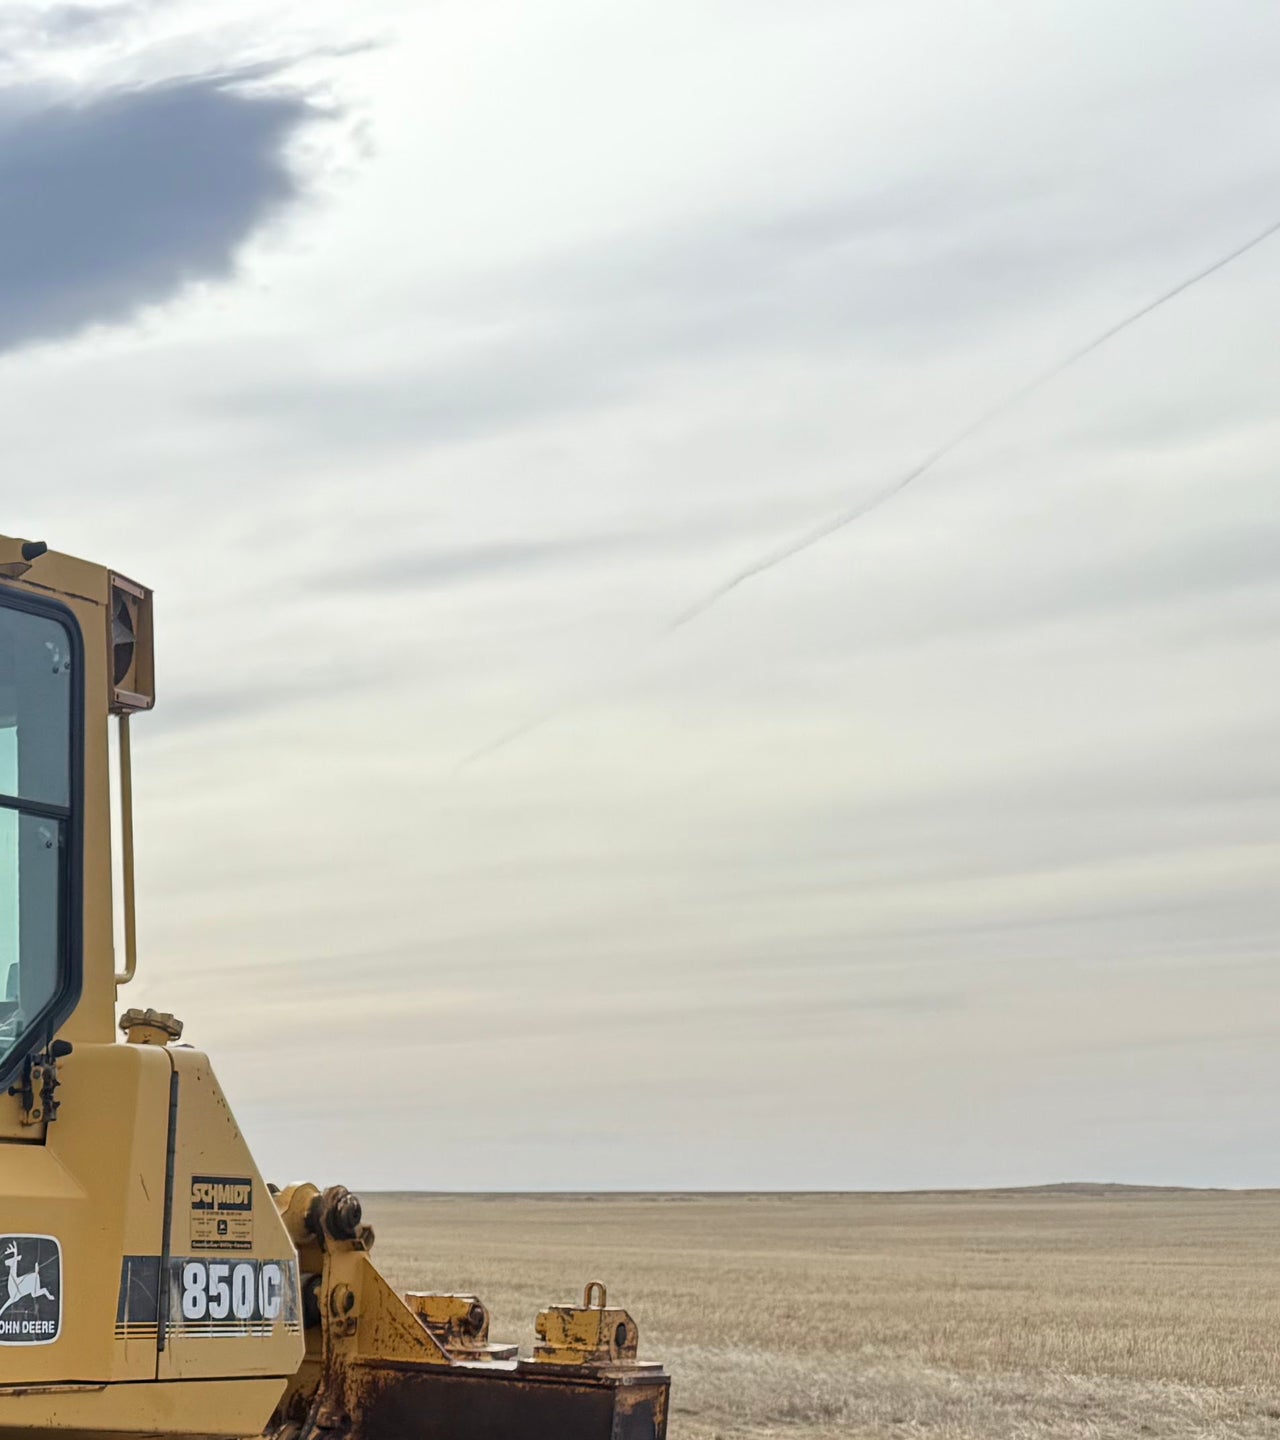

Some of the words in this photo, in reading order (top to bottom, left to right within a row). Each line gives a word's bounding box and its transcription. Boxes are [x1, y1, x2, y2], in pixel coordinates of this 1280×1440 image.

[191, 1183, 251, 1210] SCHMIDT
[183, 1262, 281, 1319] 850C
[22, 1320, 55, 1334] DEERE
